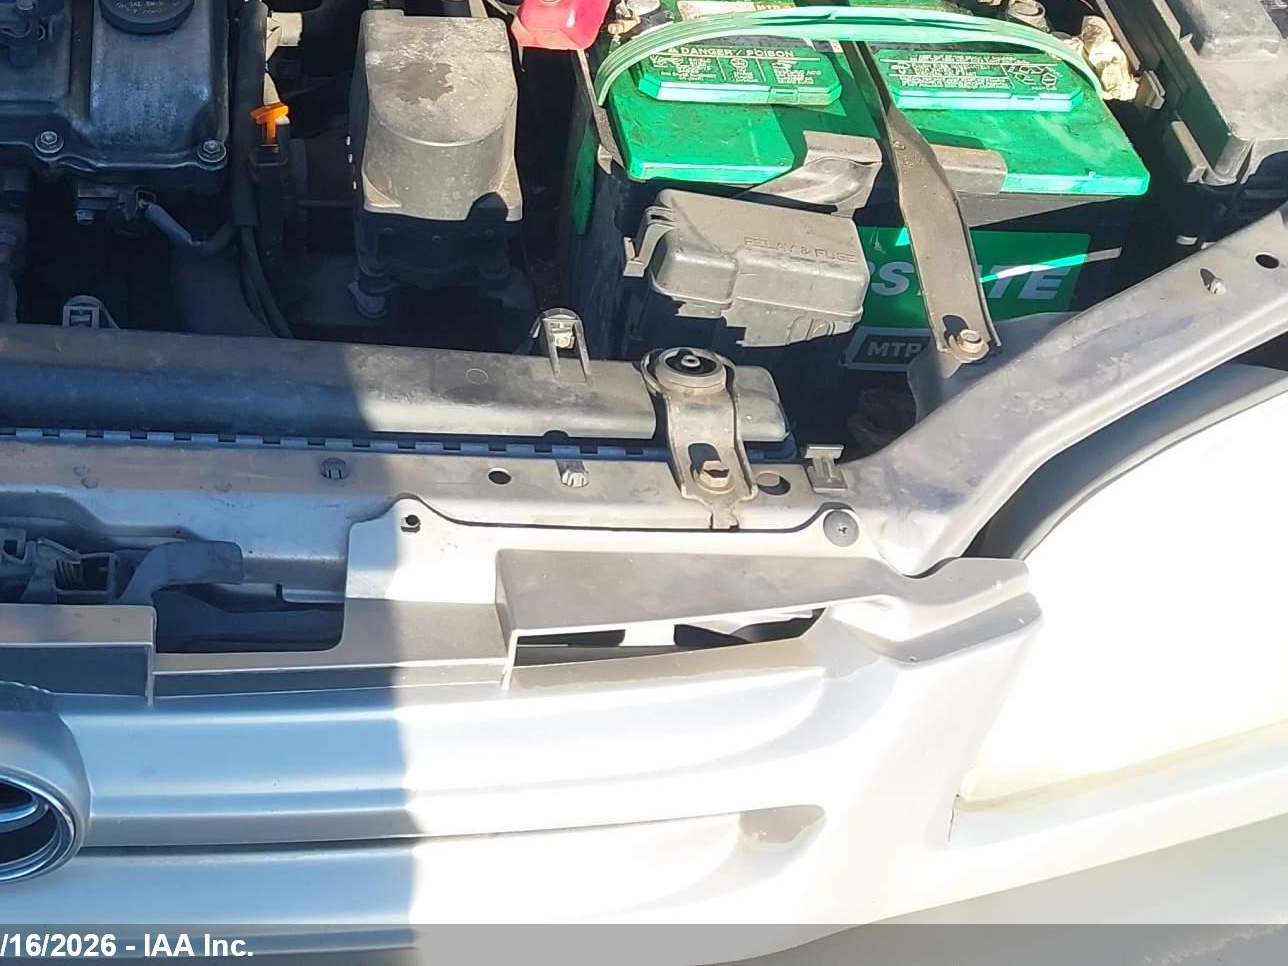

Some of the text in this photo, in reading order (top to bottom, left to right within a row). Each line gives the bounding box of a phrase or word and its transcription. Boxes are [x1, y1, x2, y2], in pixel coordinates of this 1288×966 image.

[680, 47, 733, 57] DANGER
[746, 49, 795, 58] POISON
[743, 236, 857, 264] RELAY & FUSE
